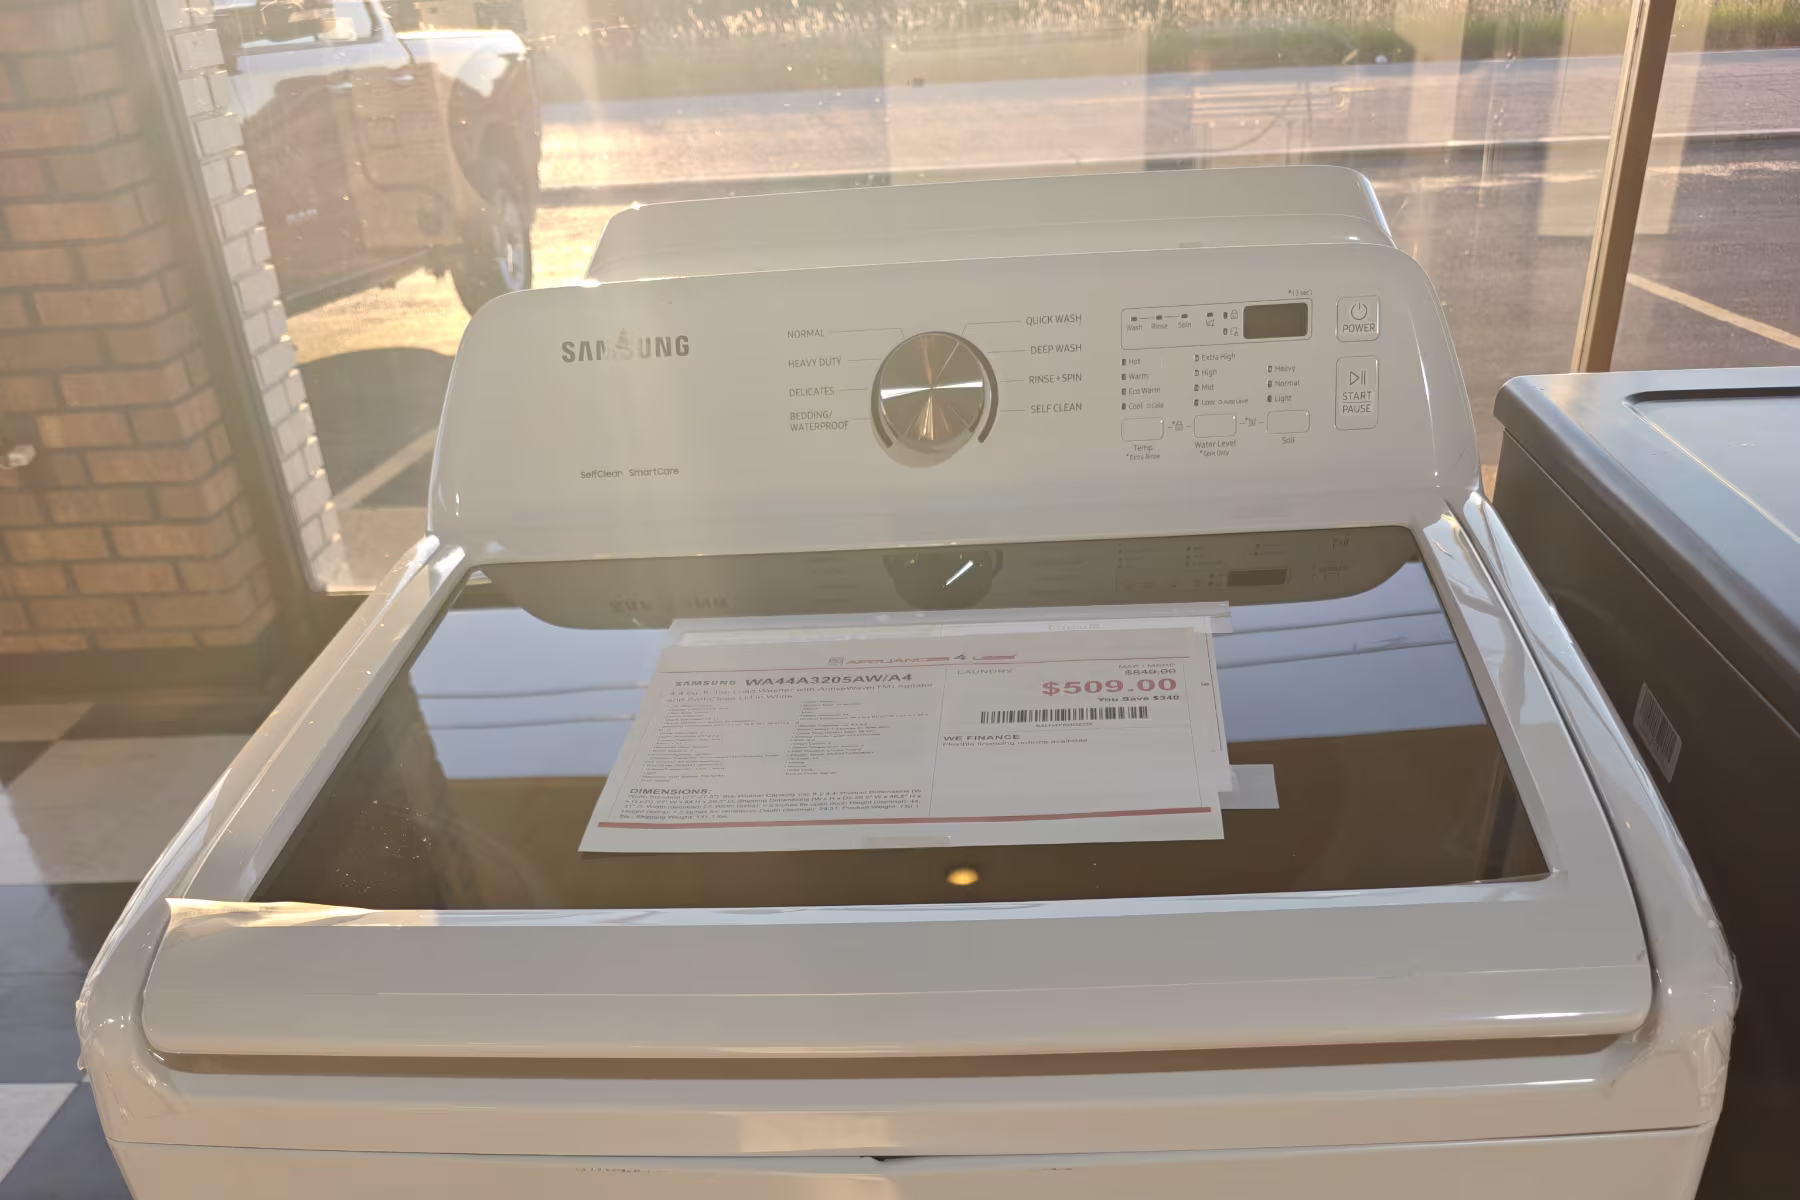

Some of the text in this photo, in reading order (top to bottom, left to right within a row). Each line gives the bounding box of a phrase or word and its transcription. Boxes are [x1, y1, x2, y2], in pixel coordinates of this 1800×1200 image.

[1026, 313, 1082, 326] QUICK WASH
[1126, 324, 1143, 332] Wash
[1178, 321, 1192, 329] Spin
[1342, 323, 1376, 333] POWER
[787, 328, 825, 338] NORMAL
[1030, 343, 1082, 355] DEEP WASH
[788, 356, 842, 368] HEAVY DUTY
[1220, 352, 1236, 362] High
[1201, 368, 1218, 378] High
[1274, 365, 1296, 373] Heavy
[1274, 379, 1300, 387] Normal
[789, 387, 835, 397] DELICATES
[1342, 391, 1372, 401] START
[1274, 395, 1292, 403] Light
[1030, 402, 1082, 414] SELF CLEAN
[1342, 404, 1372, 414] PAUSE
[790, 410, 833, 421] BEDDING/
[790, 420, 849, 432] WATERPROOF
[1194, 440, 1236, 449] Water Level
[1281, 436, 1295, 444] Soil
[580, 467, 680, 479] SelfClean SmartCare
[745, 673, 912, 687] WA44A3205AW/A4
[1041, 678, 1178, 697] $509.00
